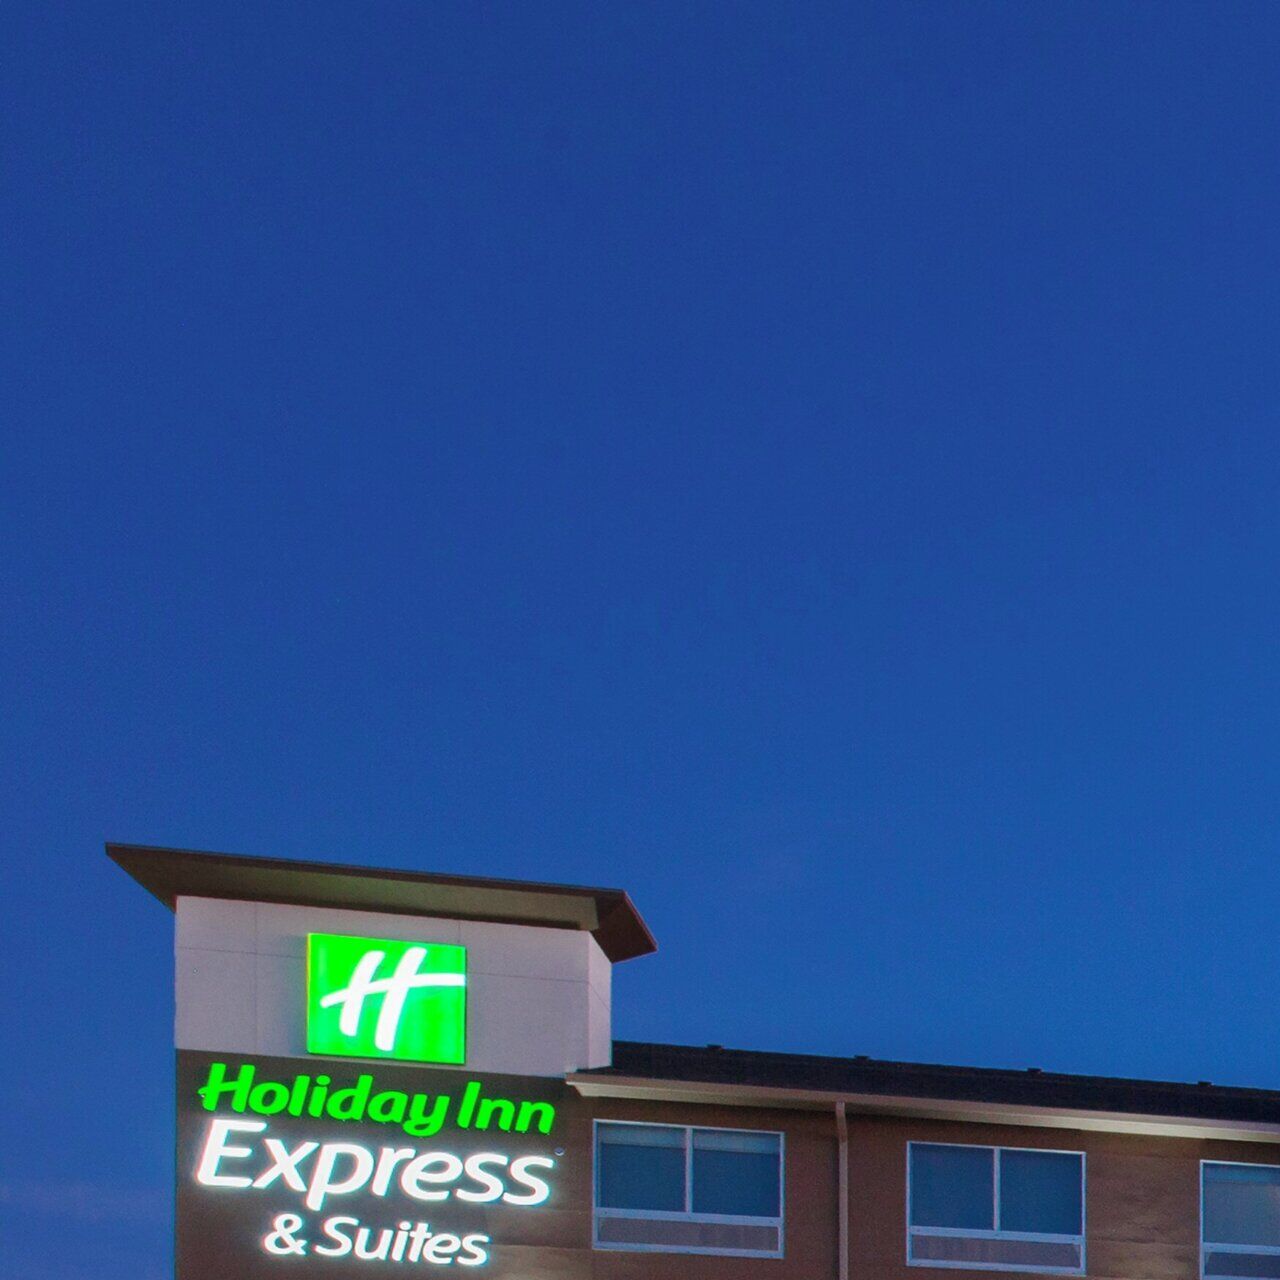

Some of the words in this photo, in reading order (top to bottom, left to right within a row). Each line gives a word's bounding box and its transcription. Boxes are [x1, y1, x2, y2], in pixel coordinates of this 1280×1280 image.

[321, 946, 466, 1051] H
[198, 1063, 450, 1137] Holiday
[457, 1081, 555, 1134] Inn
[196, 1118, 555, 1211] Express
[264, 1213, 307, 1256] &
[314, 1215, 490, 1266] Suites
